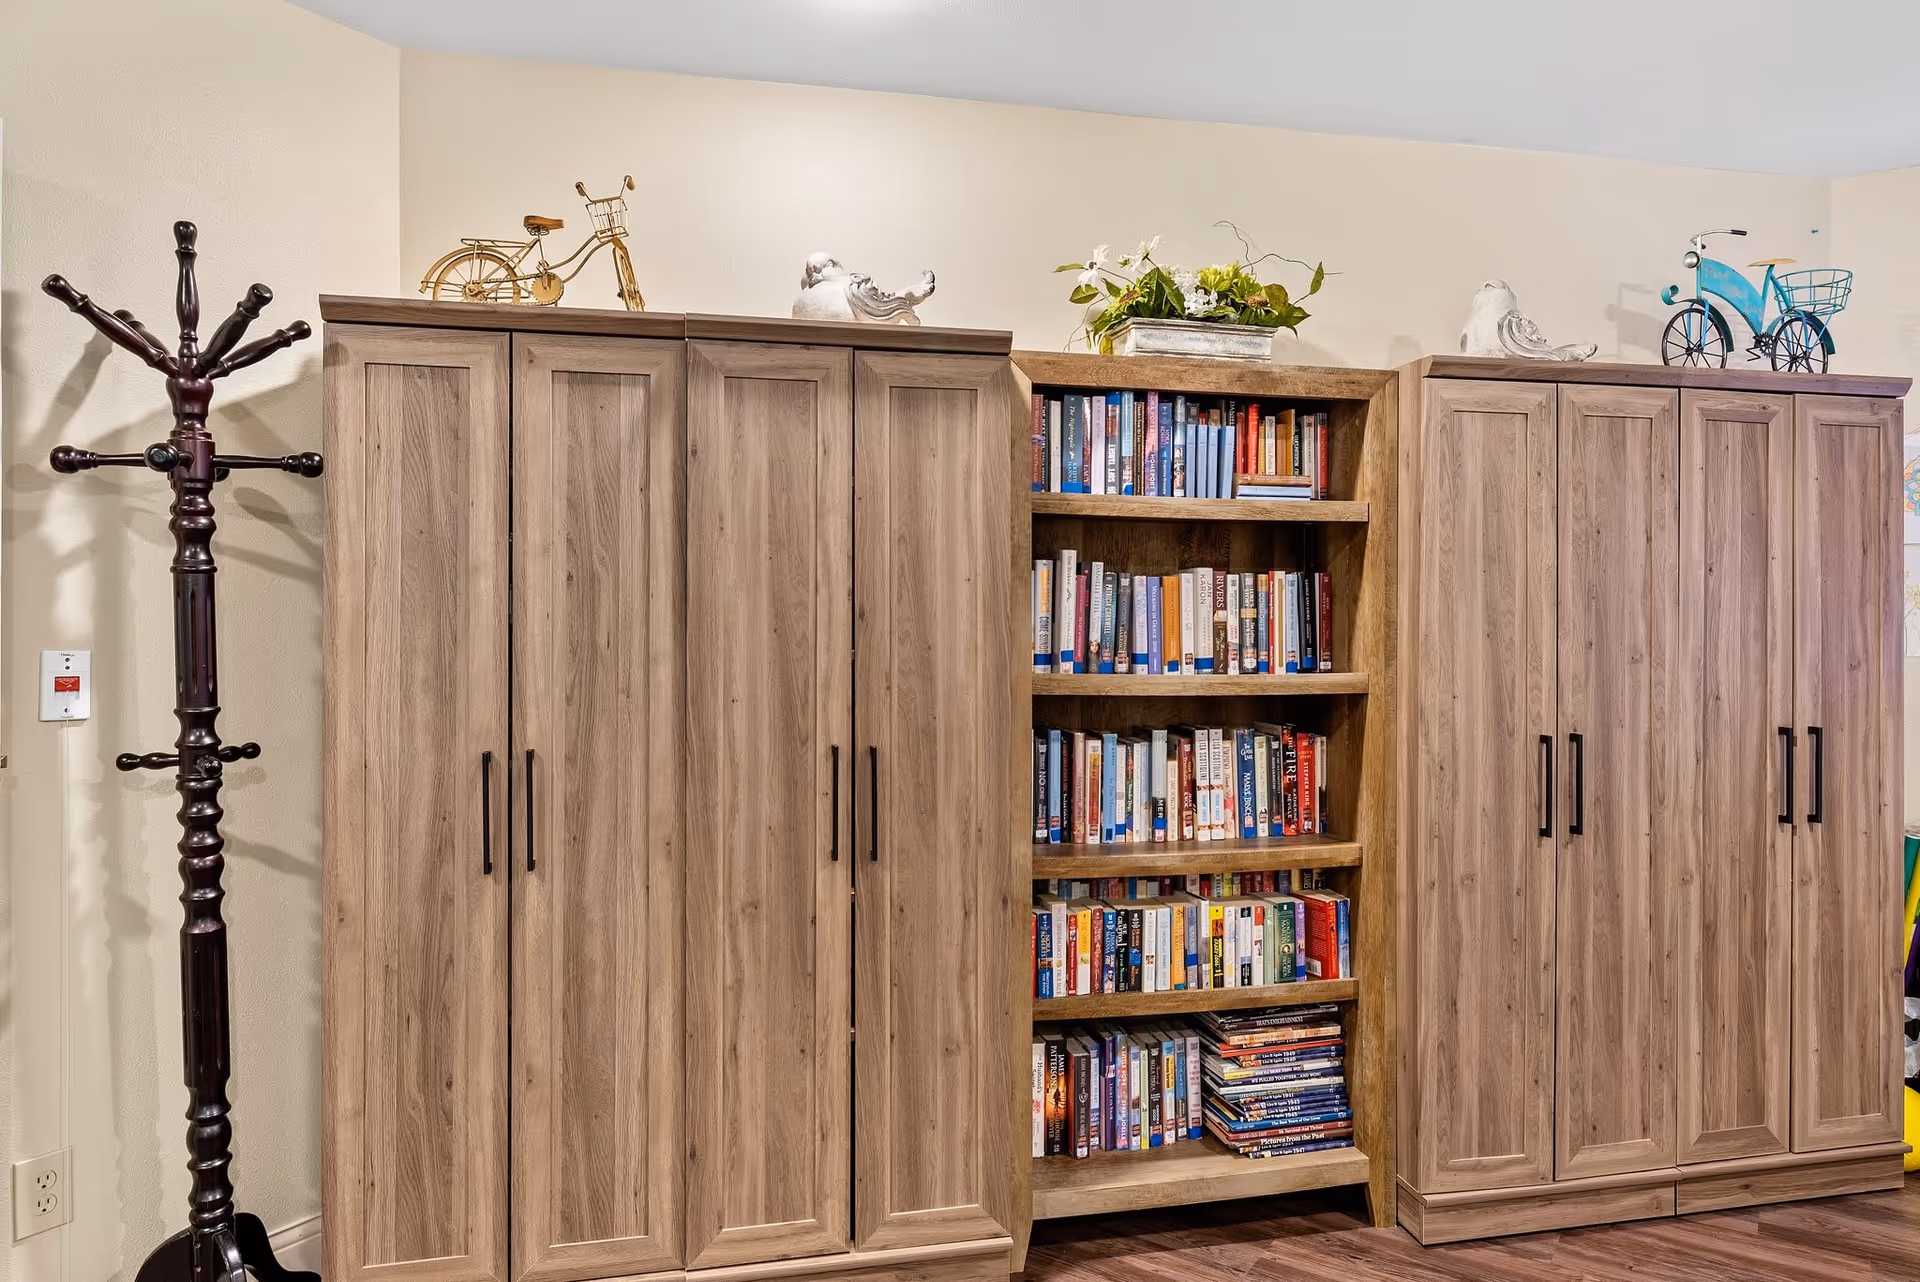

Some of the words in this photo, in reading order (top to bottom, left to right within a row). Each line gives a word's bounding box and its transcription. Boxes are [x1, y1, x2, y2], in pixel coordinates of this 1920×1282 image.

[1108, 444, 1116, 465] TARGET
[1094, 564, 1102, 594] DANIELLE
[1105, 584, 1113, 606] PATRICIA
[1216, 576, 1224, 608] RIVERS
[1039, 616, 1049, 632] COME
[1104, 608, 1112, 634] CORNWELL
[1039, 634, 1048, 653] SUNDO
[1212, 738, 1220, 749] LISA
[1213, 750, 1221, 780] SCOTTOLINE
[1286, 750, 1296, 783] FIRE
[1039, 771, 1046, 785] NO
[1244, 797, 1252, 817] BINCH
[1271, 1016, 1304, 1025] ENTERTAINMENT
[1050, 1045, 1058, 1086] PATTERSON
[1261, 1137, 1285, 1145] Pictures
